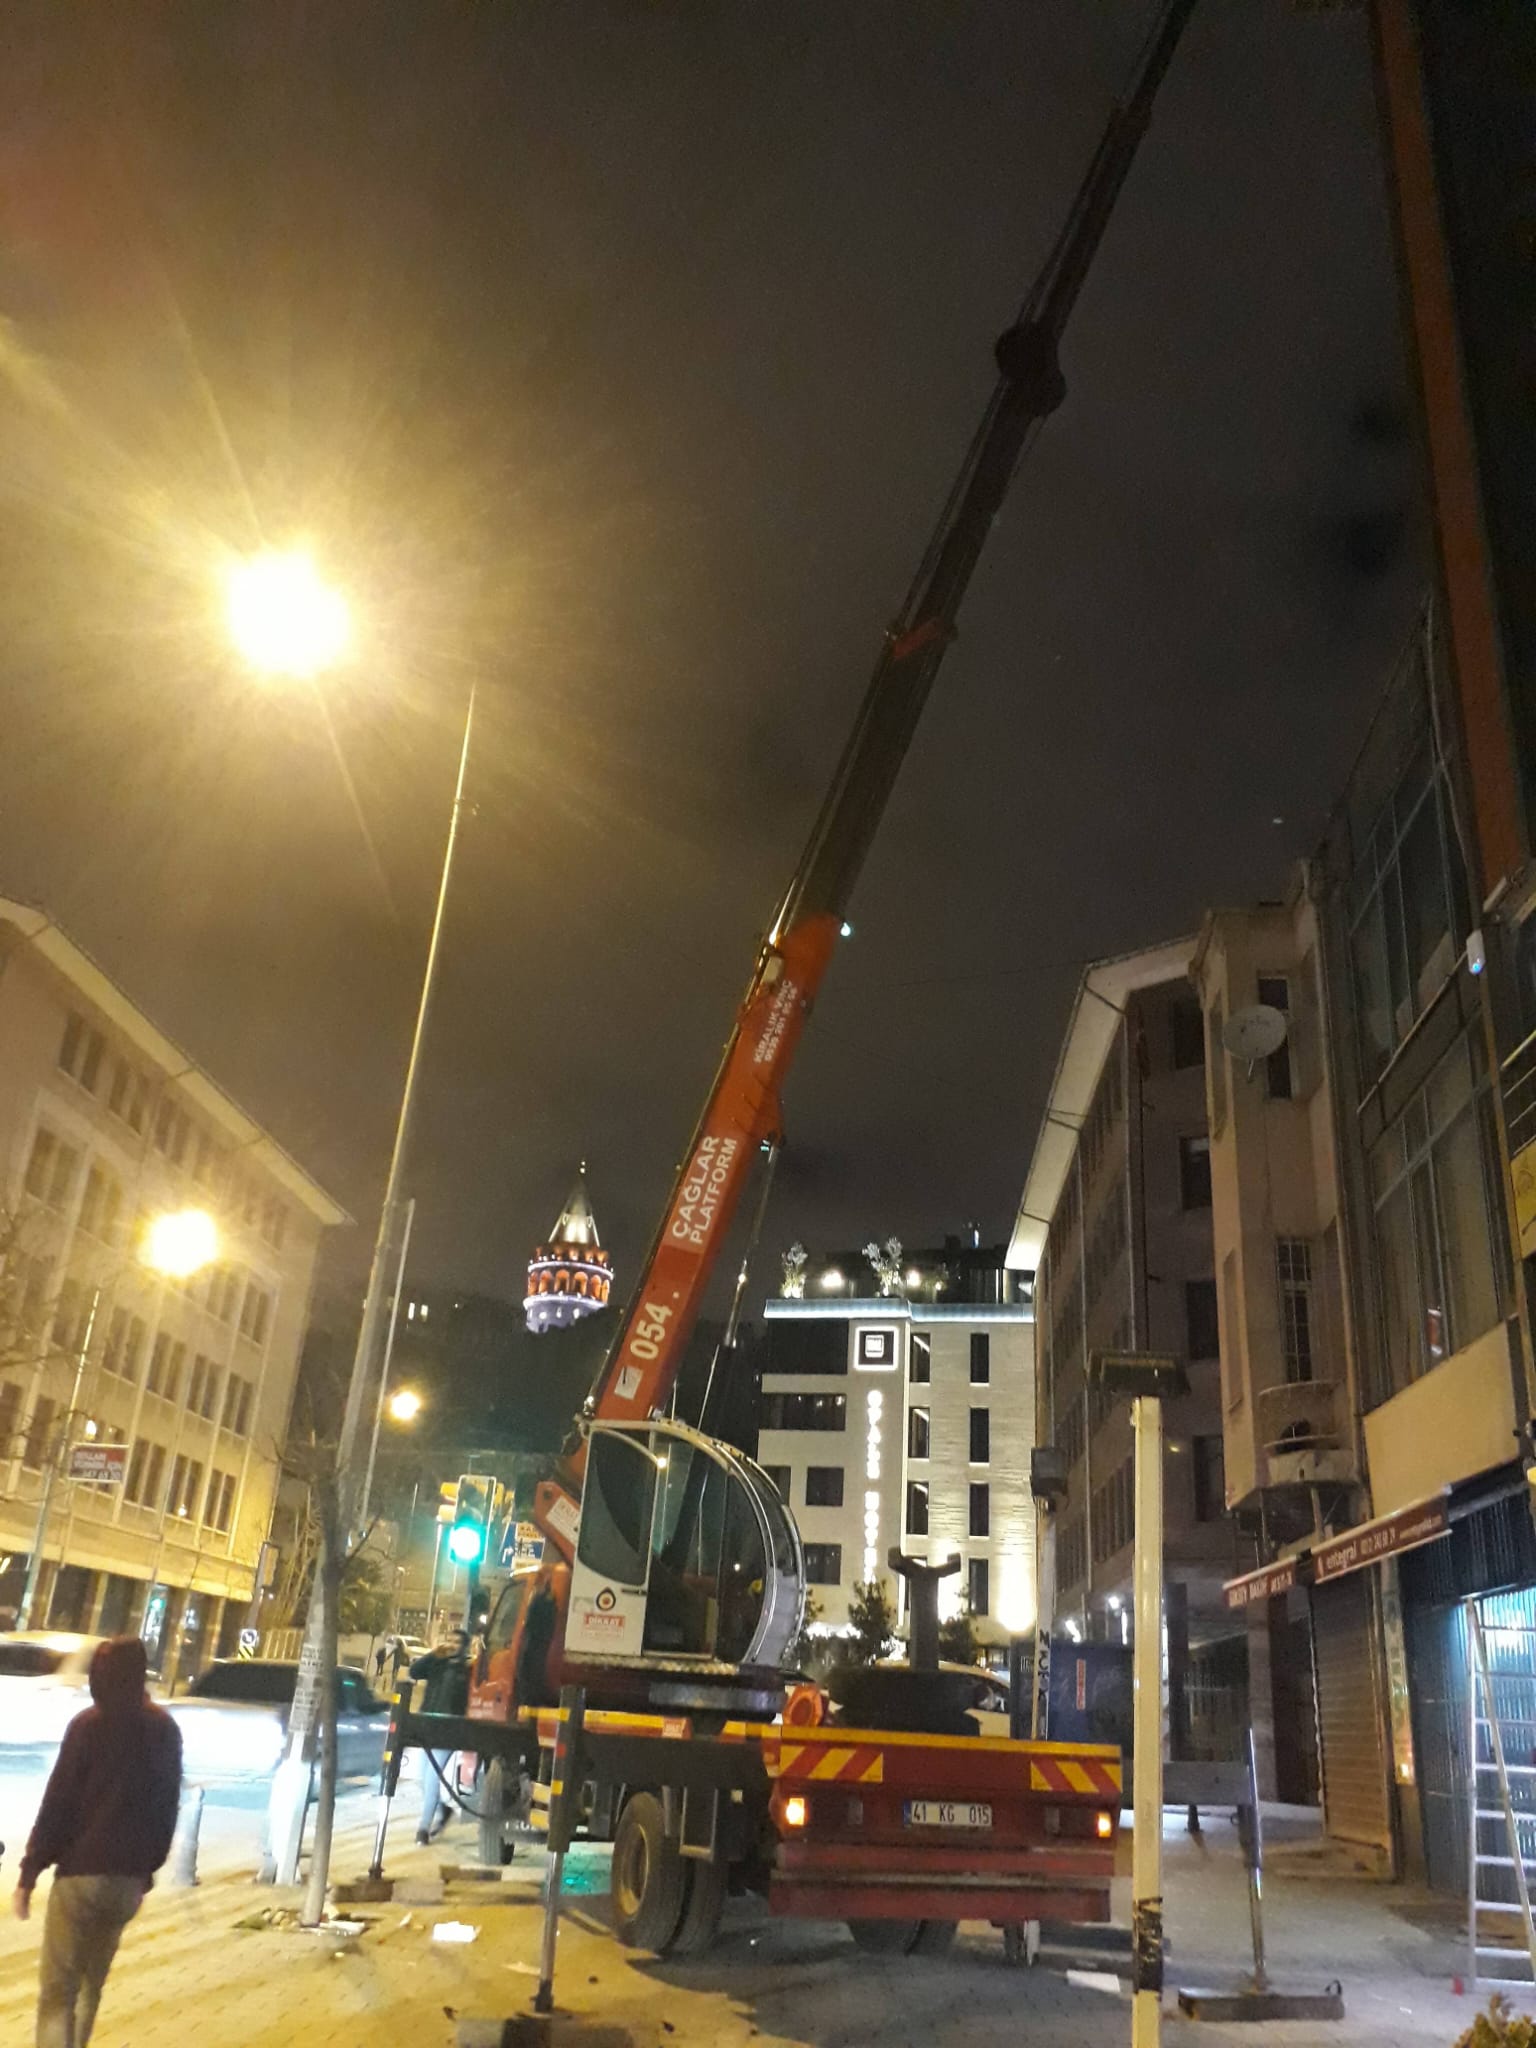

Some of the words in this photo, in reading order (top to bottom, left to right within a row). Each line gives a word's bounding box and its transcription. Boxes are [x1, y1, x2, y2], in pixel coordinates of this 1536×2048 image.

[672, 1134, 720, 1239] ÇAĞLAR
[689, 1137, 737, 1245] PLATFORM
[630, 1301, 672, 1361] 054
[913, 1802, 927, 1823] 41
[939, 1803, 955, 1824] KG
[969, 1805, 990, 1826] 015
